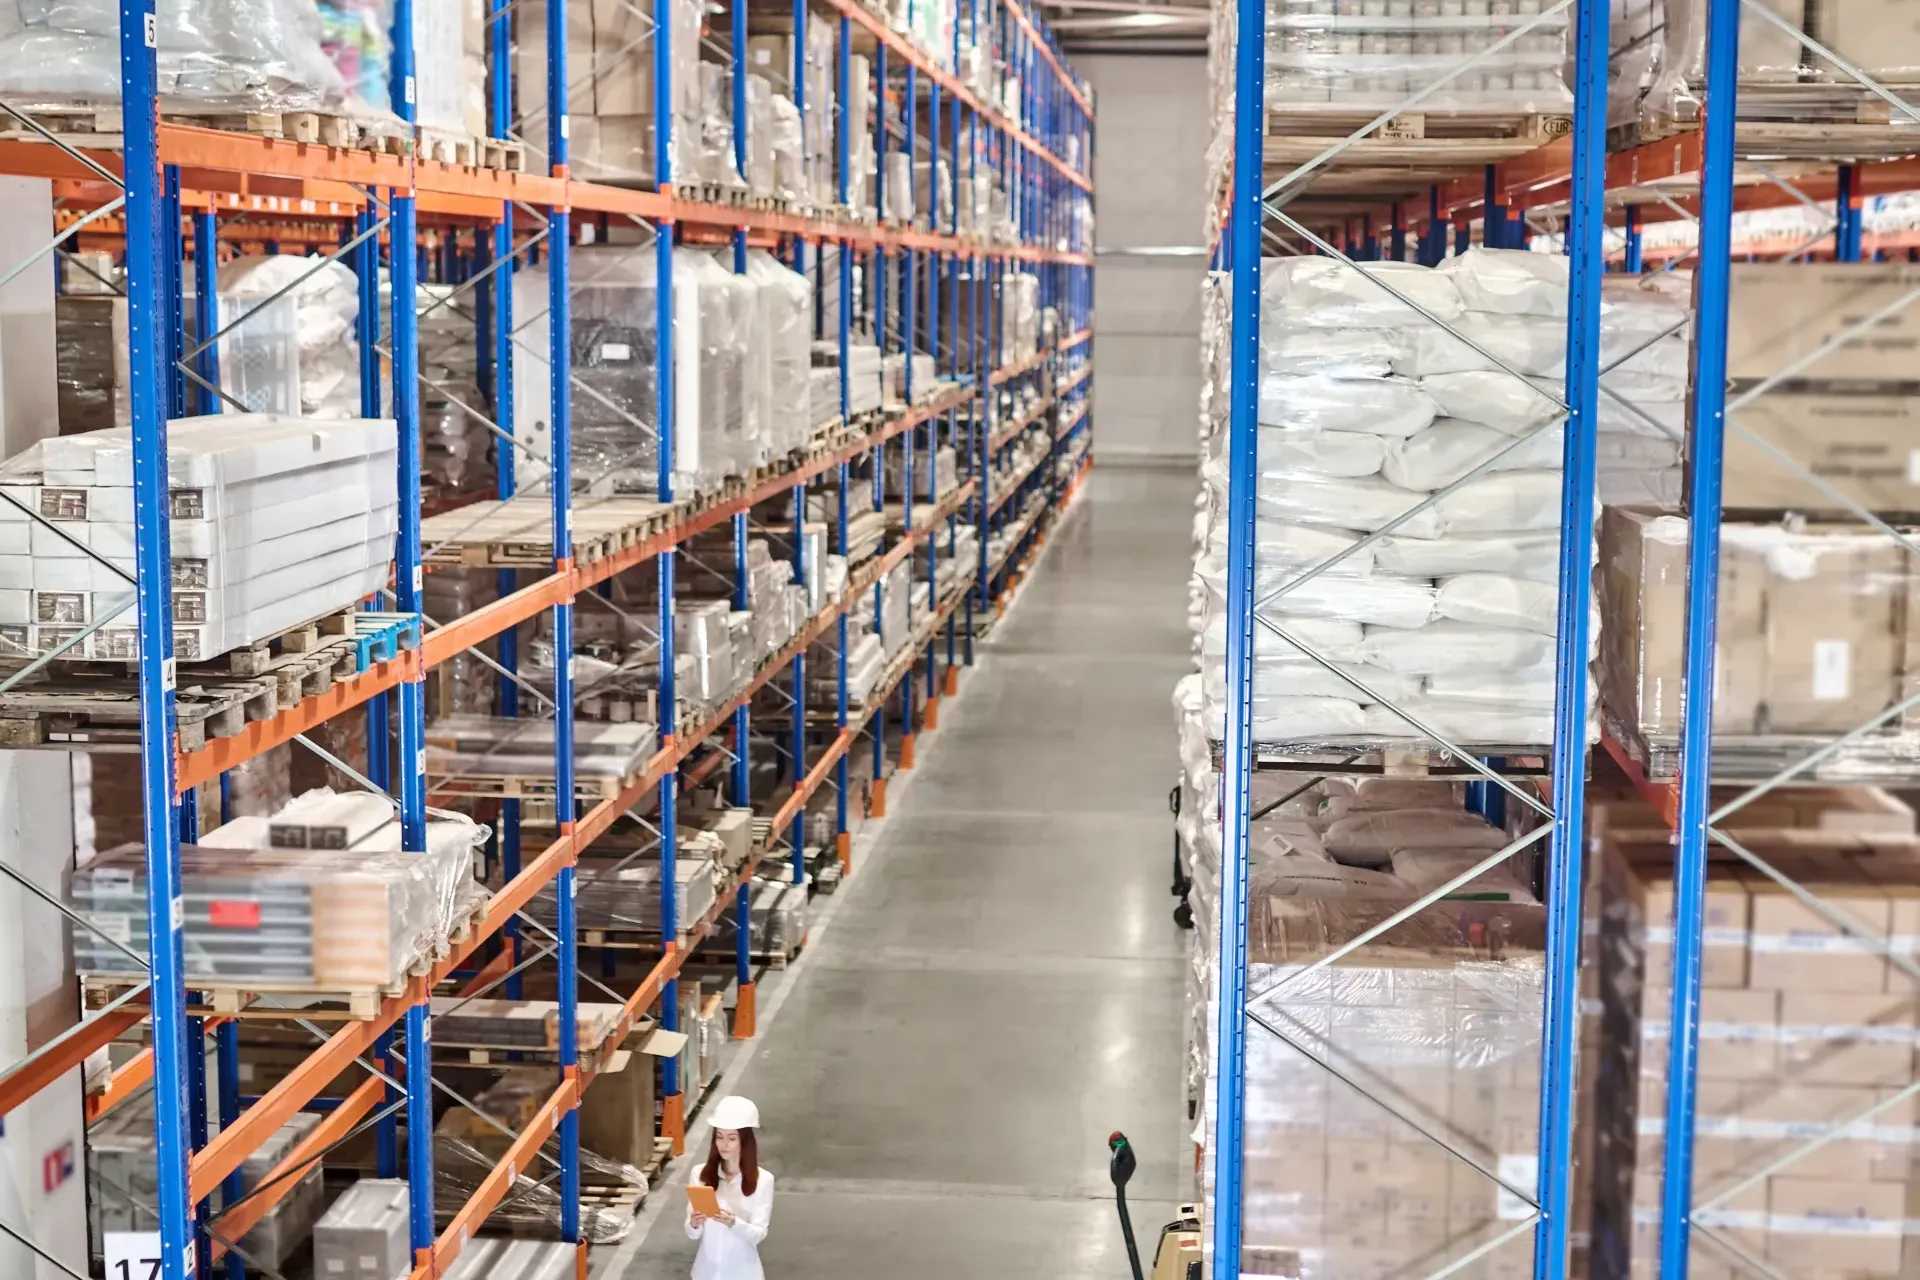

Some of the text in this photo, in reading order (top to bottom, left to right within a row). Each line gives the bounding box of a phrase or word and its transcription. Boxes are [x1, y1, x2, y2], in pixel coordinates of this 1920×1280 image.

[148, 19, 155, 43] 5
[1550, 121, 1569, 133] EUR
[166, 662, 173, 686] 4
[187, 1246, 194, 1269] 2
[115, 1259, 162, 1280] 17
